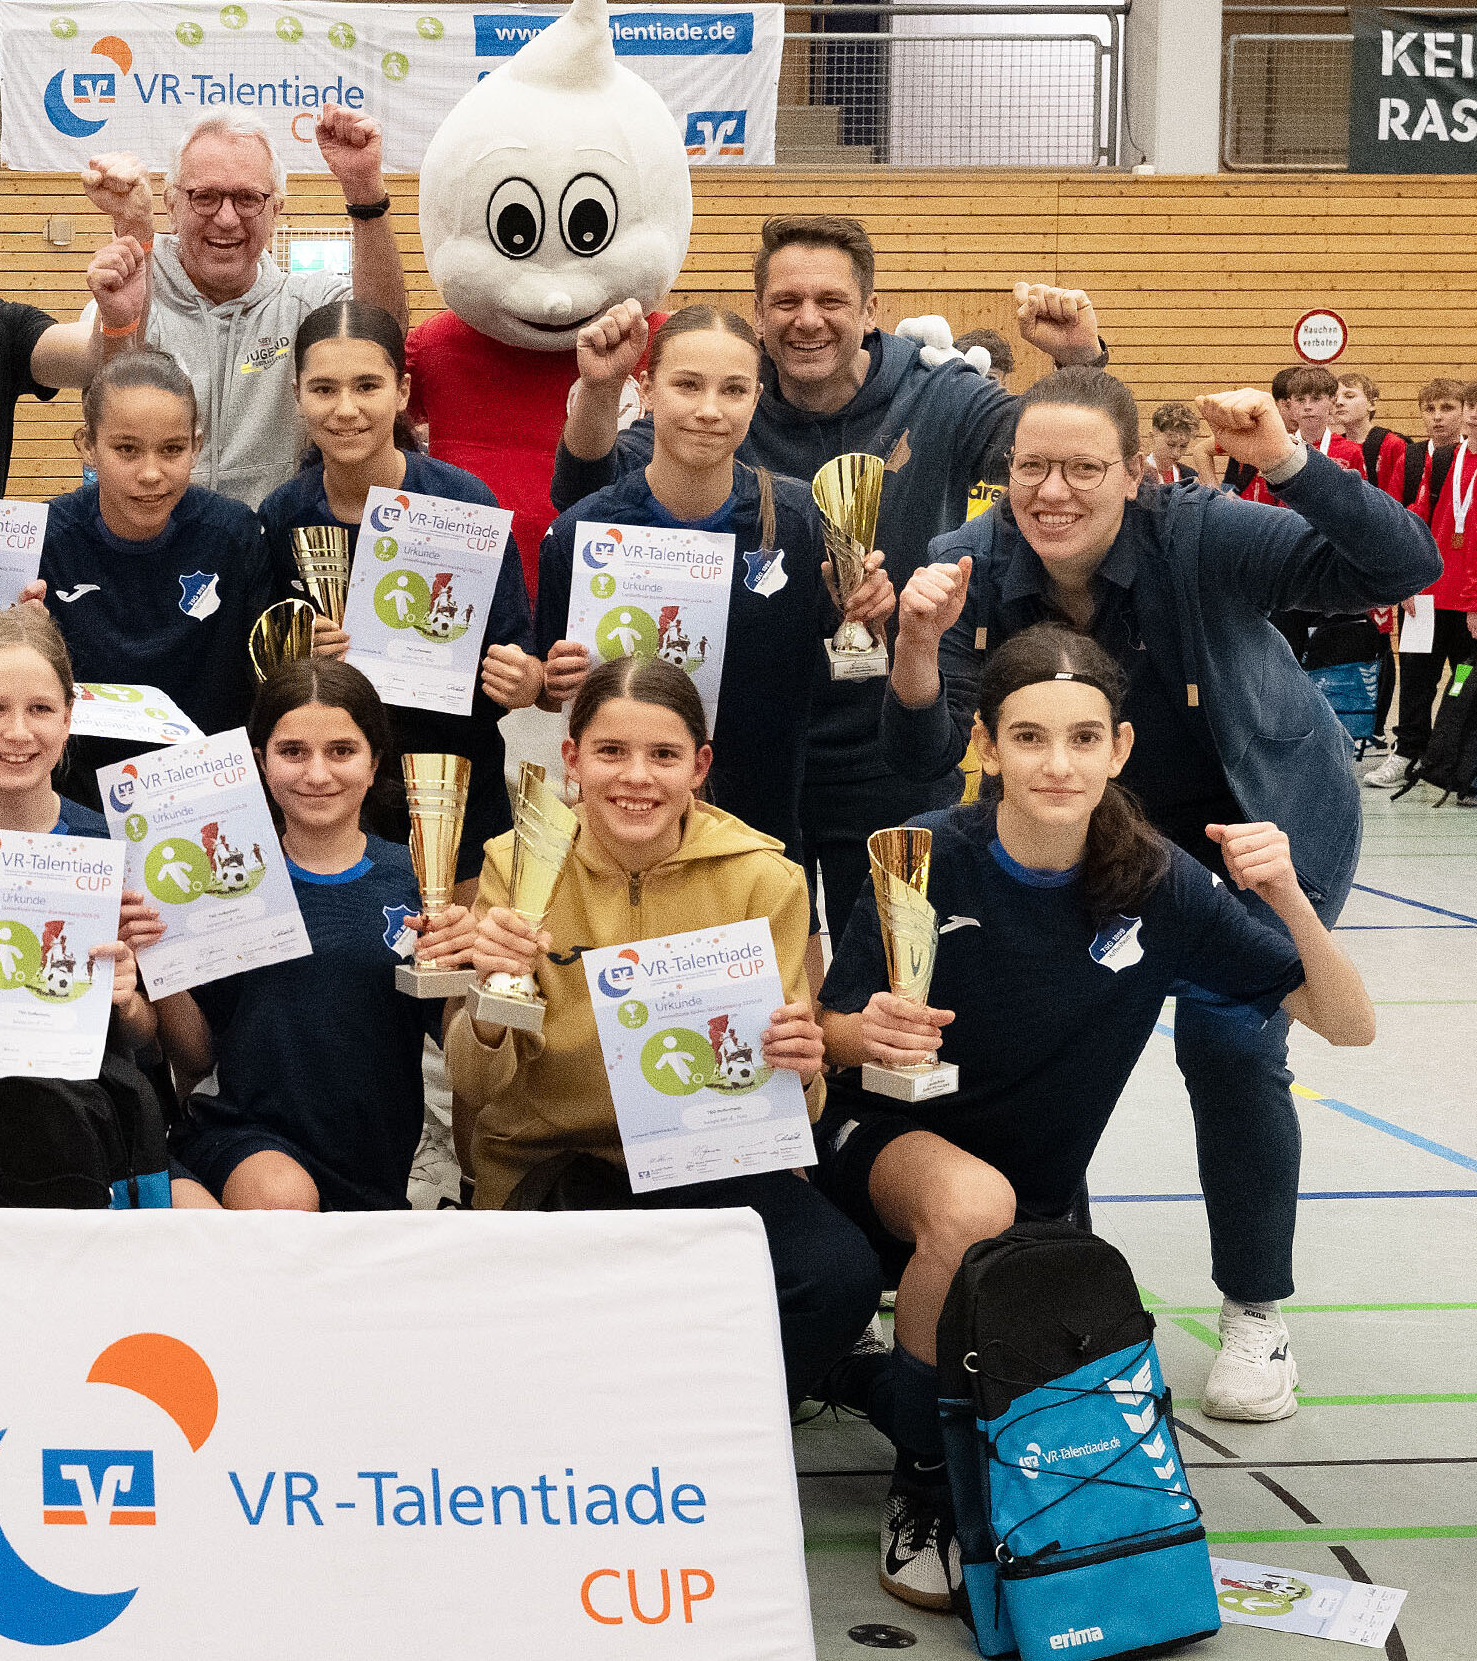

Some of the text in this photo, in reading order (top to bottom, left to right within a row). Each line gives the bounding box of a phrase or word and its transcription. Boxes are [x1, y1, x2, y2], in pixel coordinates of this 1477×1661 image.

[133, 72, 366, 110] VR-Talentiade
[1303, 325, 1338, 334] Rauchen
[1303, 338, 1338, 347] verboten
[407, 511, 500, 540] VR-Talentiade
[6, 533, 36, 550] CUP
[466, 537, 497, 553] CUP
[622, 544, 724, 566] VR-Talentiade
[689, 564, 722, 580] CUP
[139, 752, 244, 790] VR-Talentiade
[212, 766, 248, 788] CUP
[1, 851, 113, 876] VR-Talentiade
[75, 875, 112, 892] CUP
[640, 942, 764, 977] VR-Talentiade
[726, 959, 765, 979] CUP
[1041, 1436, 1122, 1464] VR-Talentiade.de
[227, 1466, 708, 1527] VR-Talentiade
[580, 1567, 716, 1626] CUP
[1049, 1623, 1104, 1651] erima
